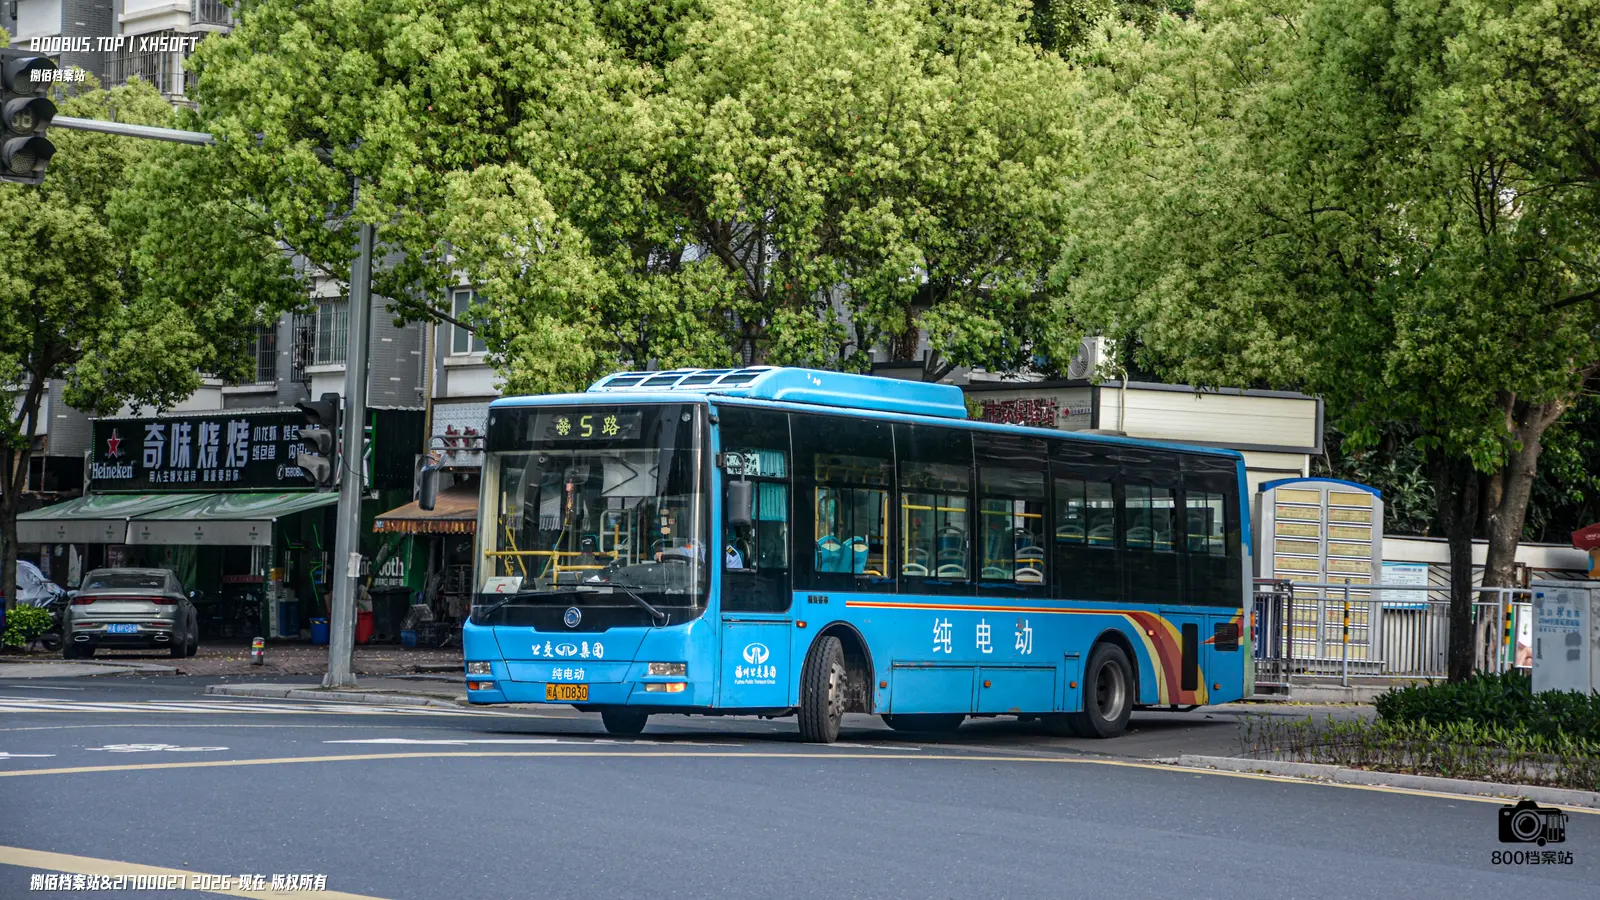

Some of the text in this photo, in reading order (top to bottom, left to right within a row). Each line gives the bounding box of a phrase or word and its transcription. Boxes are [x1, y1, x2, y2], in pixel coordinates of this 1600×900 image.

[253, 425, 277, 442] 小龙虾
[580, 415, 620, 437] 5 路
[143, 419, 250, 469] 奇味烧烤
[252, 444, 276, 460] 纸包鱼
[92, 461, 133, 479] Heineken
[932, 617, 1033, 655] 纯电动
[551, 667, 585, 681] 纯电动
